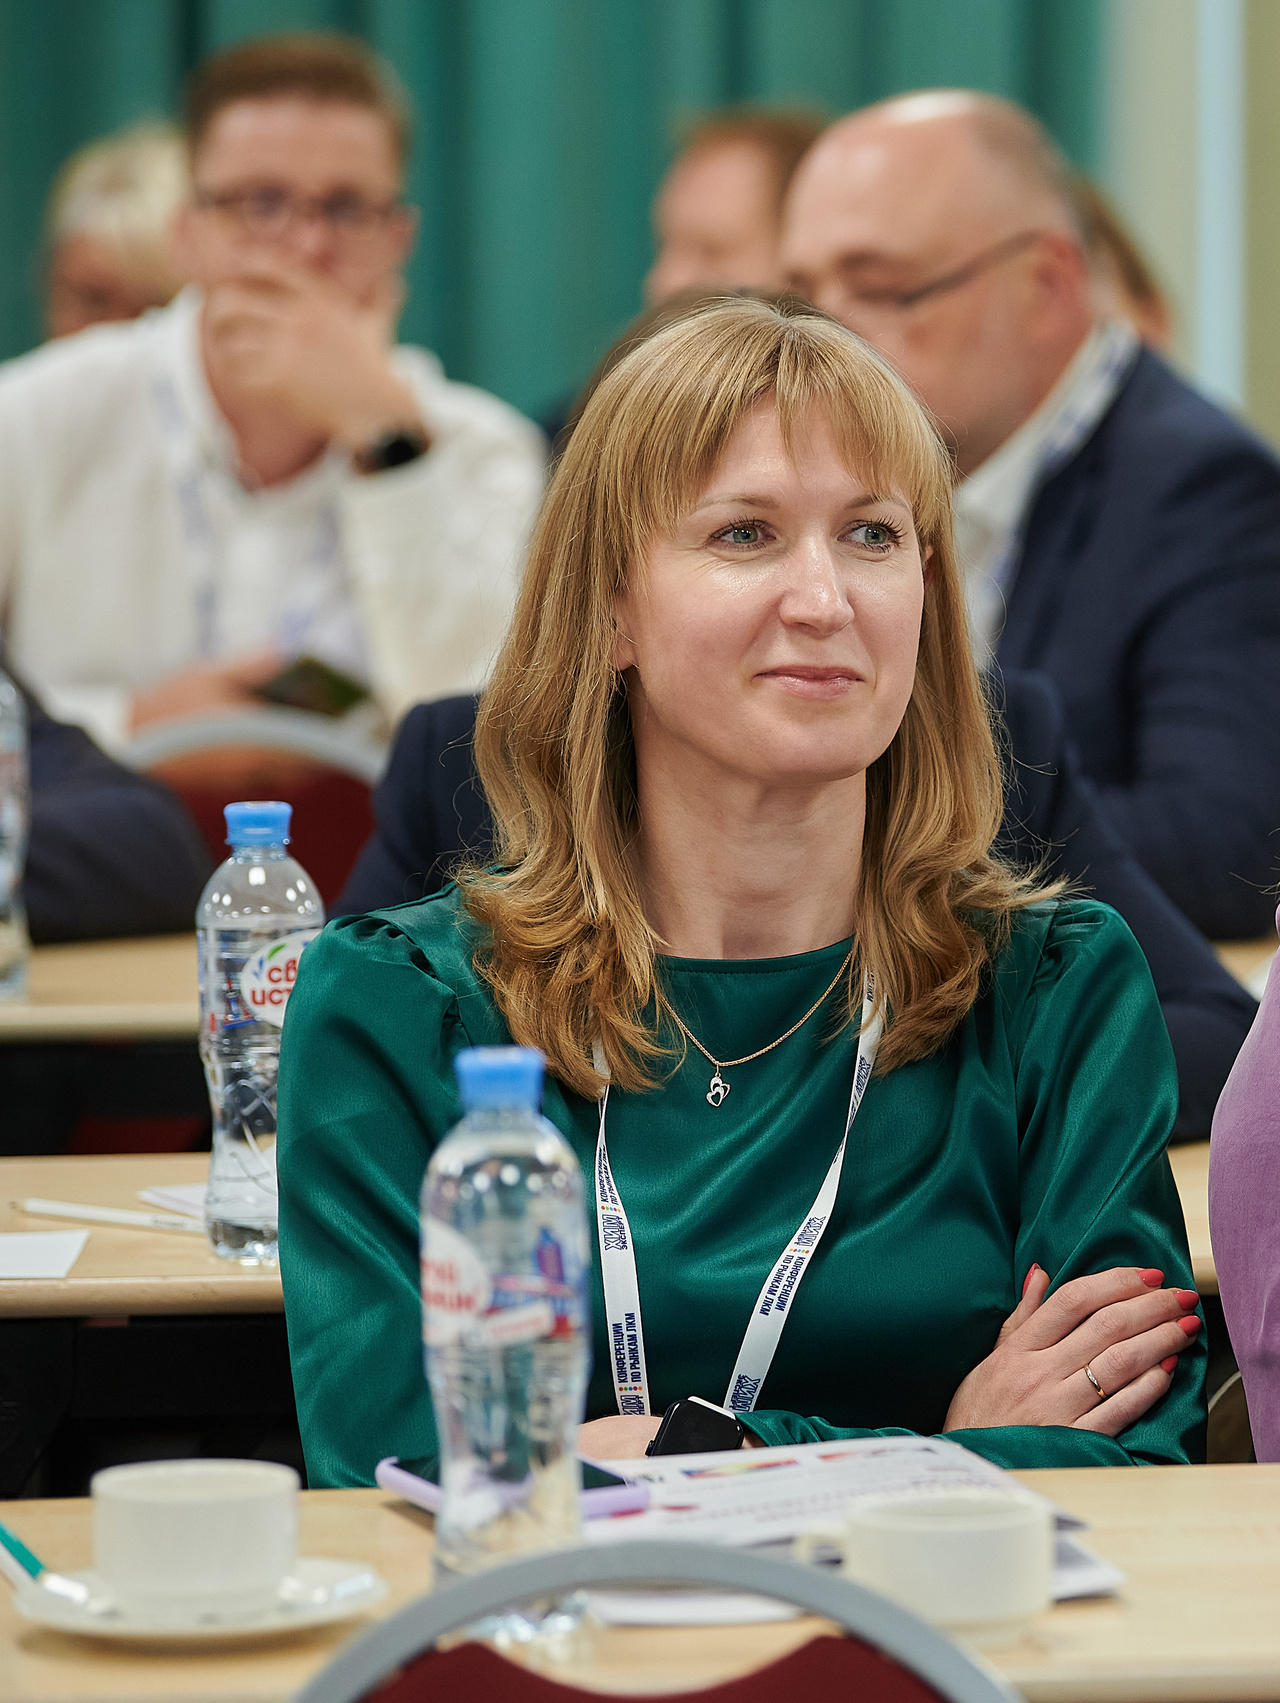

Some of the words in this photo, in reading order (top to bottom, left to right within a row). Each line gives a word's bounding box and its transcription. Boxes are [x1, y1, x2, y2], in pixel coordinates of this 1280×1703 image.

[602, 1214, 622, 1251] ХИМ
[618, 1216, 628, 1250] ЭКСПЕРТ
[799, 1216, 826, 1247] ХИМ
[783, 1254, 795, 1264] ПО
[767, 1264, 789, 1296] РЫНКАМ
[775, 1256, 806, 1311] КОНФЕРЕНЦИИ
[625, 1312, 637, 1332] ЛКМ
[759, 1296, 774, 1316] ЛКМ
[612, 1322, 628, 1383] КОНФЕРЕНЦИИ
[627, 1334, 640, 1371] РЫНКАМ
[631, 1371, 641, 1382] ПО
[736, 1375, 761, 1411] ХИМ
